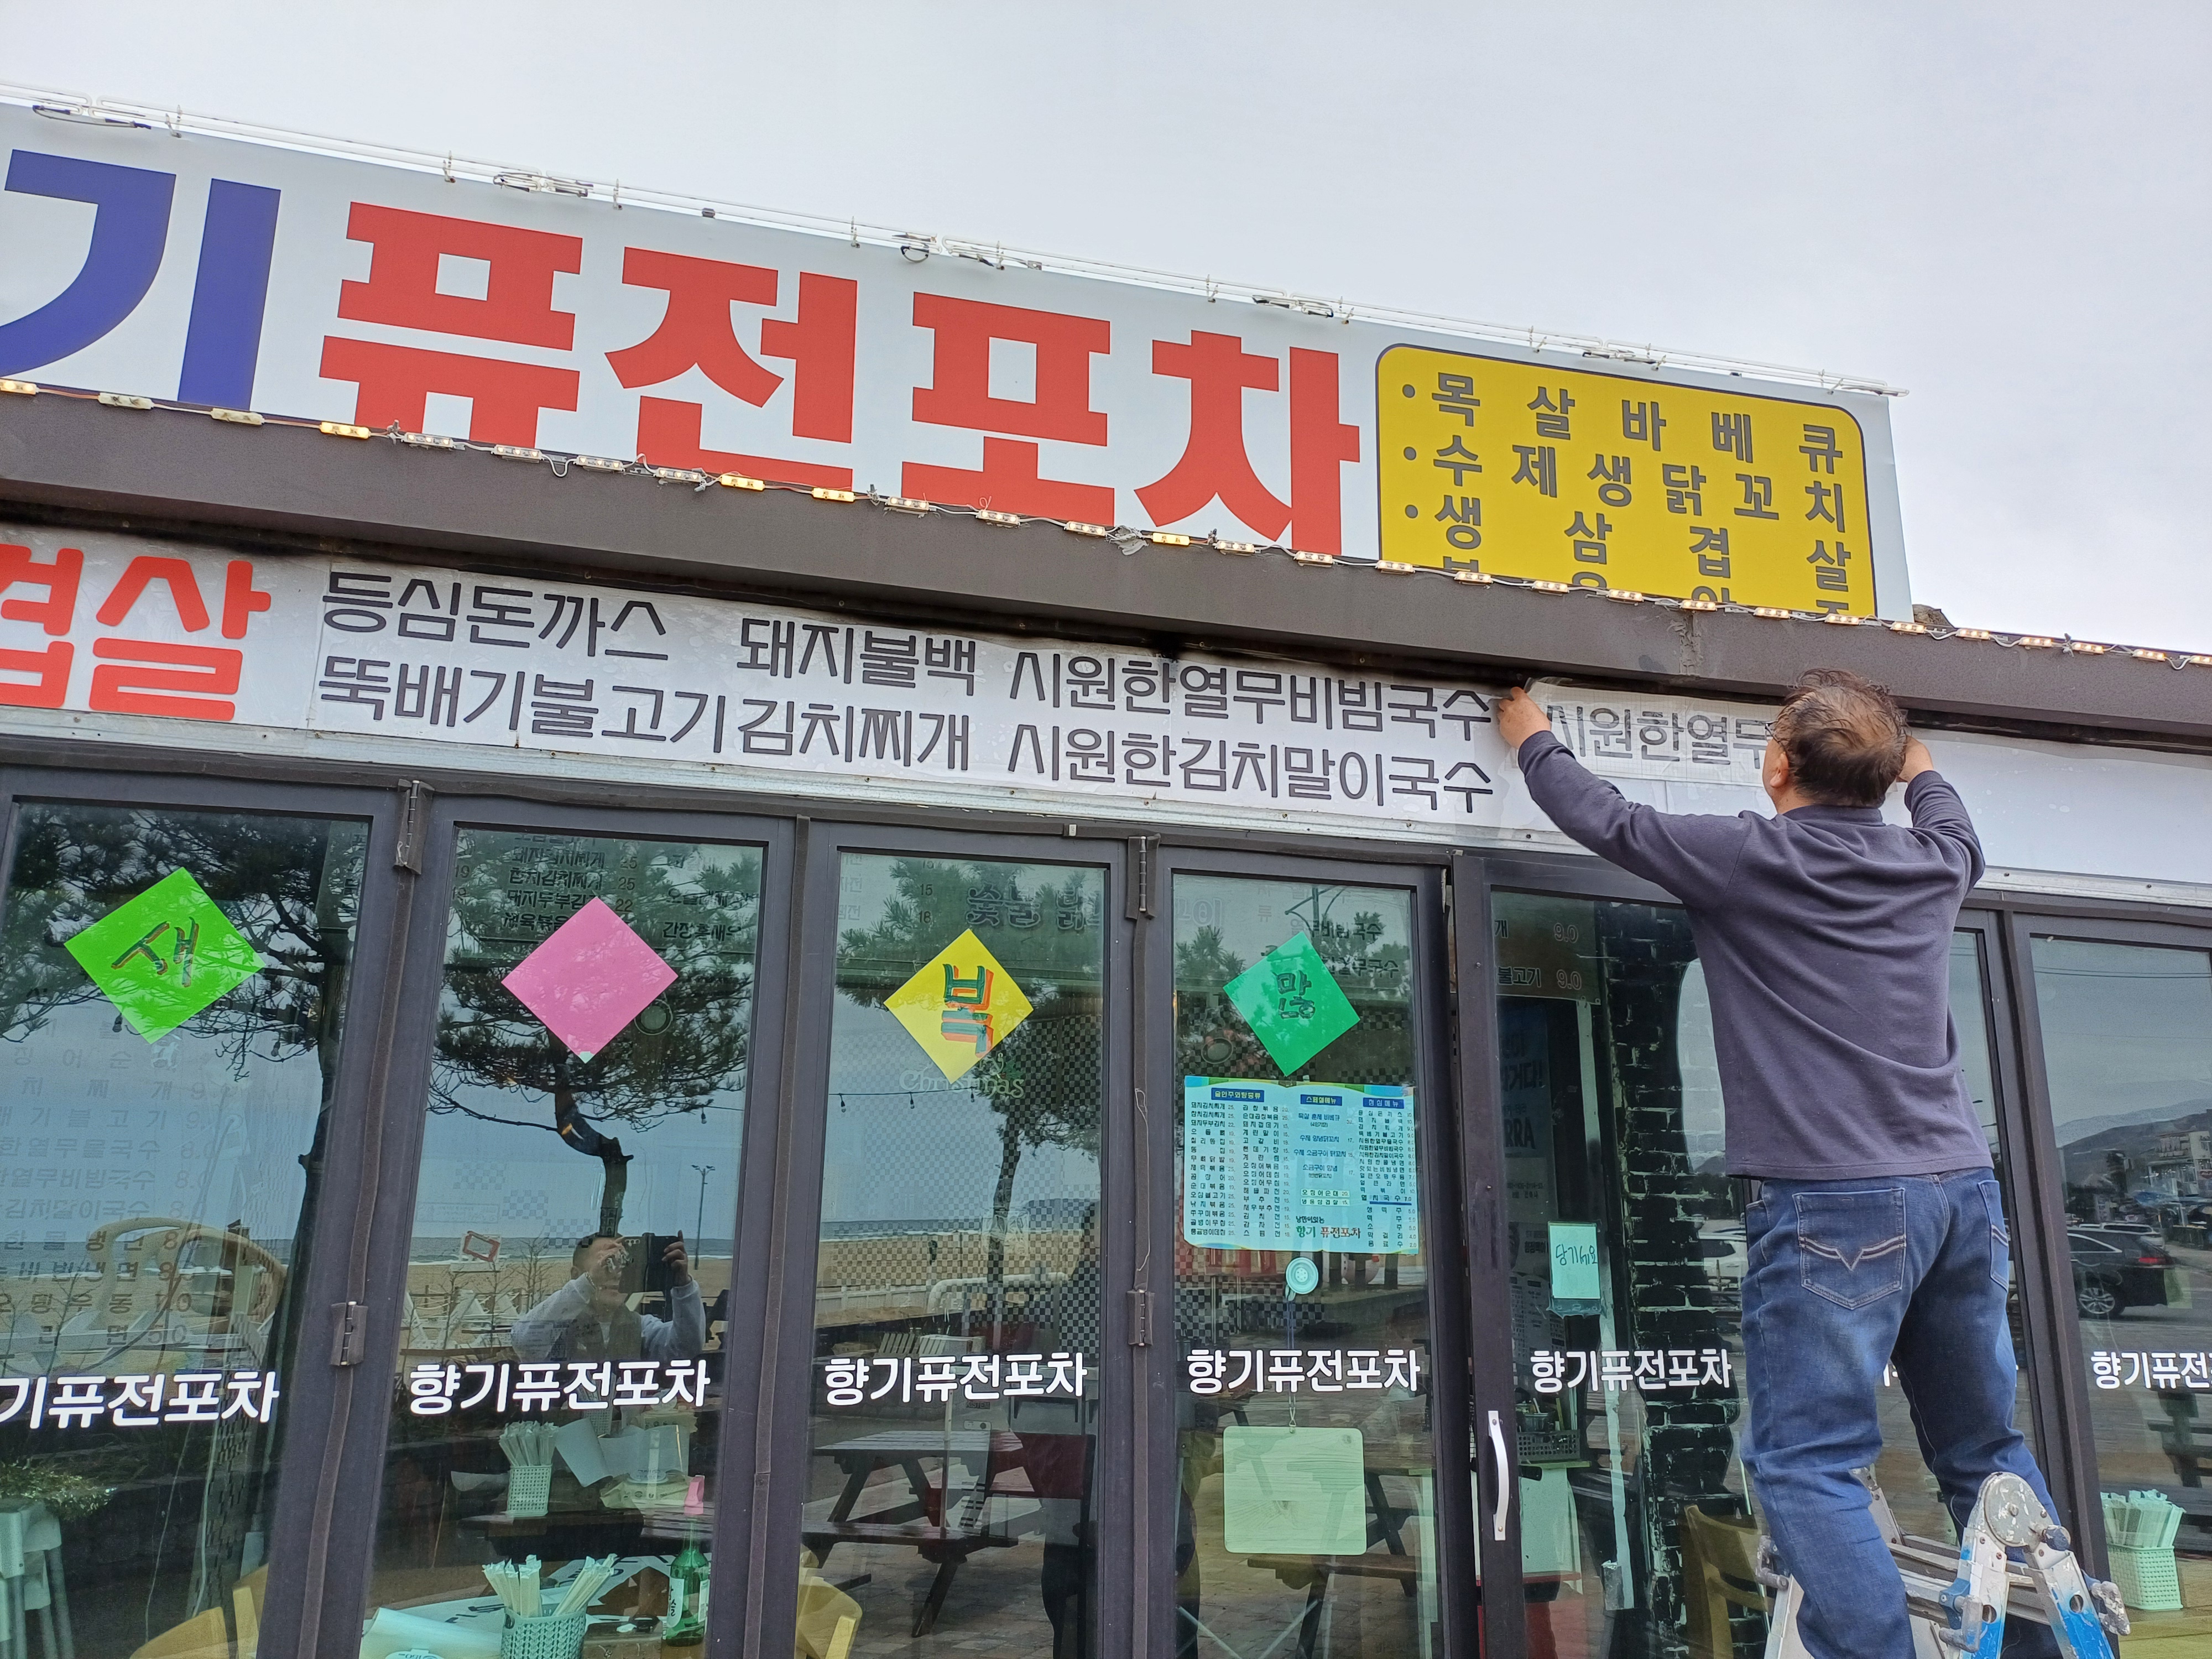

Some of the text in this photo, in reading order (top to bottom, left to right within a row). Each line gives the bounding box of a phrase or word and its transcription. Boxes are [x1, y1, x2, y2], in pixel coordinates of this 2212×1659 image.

[322, 572, 1493, 740] 등심돈까스 돼지불백 시원한열무비빔국수
[1008, 724, 1493, 813] 시원한김치말이국수
[618, 877, 636, 891] 25
[919, 884, 933, 896] 15
[615, 898, 633, 912] 22
[918, 910, 931, 924] 18
[1553, 922, 1579, 944] 9.0
[1556, 969, 1583, 991] 9.0
[941, 963, 994, 1058] 복
[1296, 1226, 1360, 1239] 향기 퓨전포차
[410, 1359, 711, 1415] 향기퓨전포차
[825, 1352, 1088, 1406] 향기퓨전포차
[1187, 1349, 1421, 1394] 향기퓨전포차
[1530, 1348, 1732, 1394] 향기퓨전포차
[2090, 1351, 2212, 1389] 향기퓨전
[0, 1371, 280, 1429] 기퓨전포차
